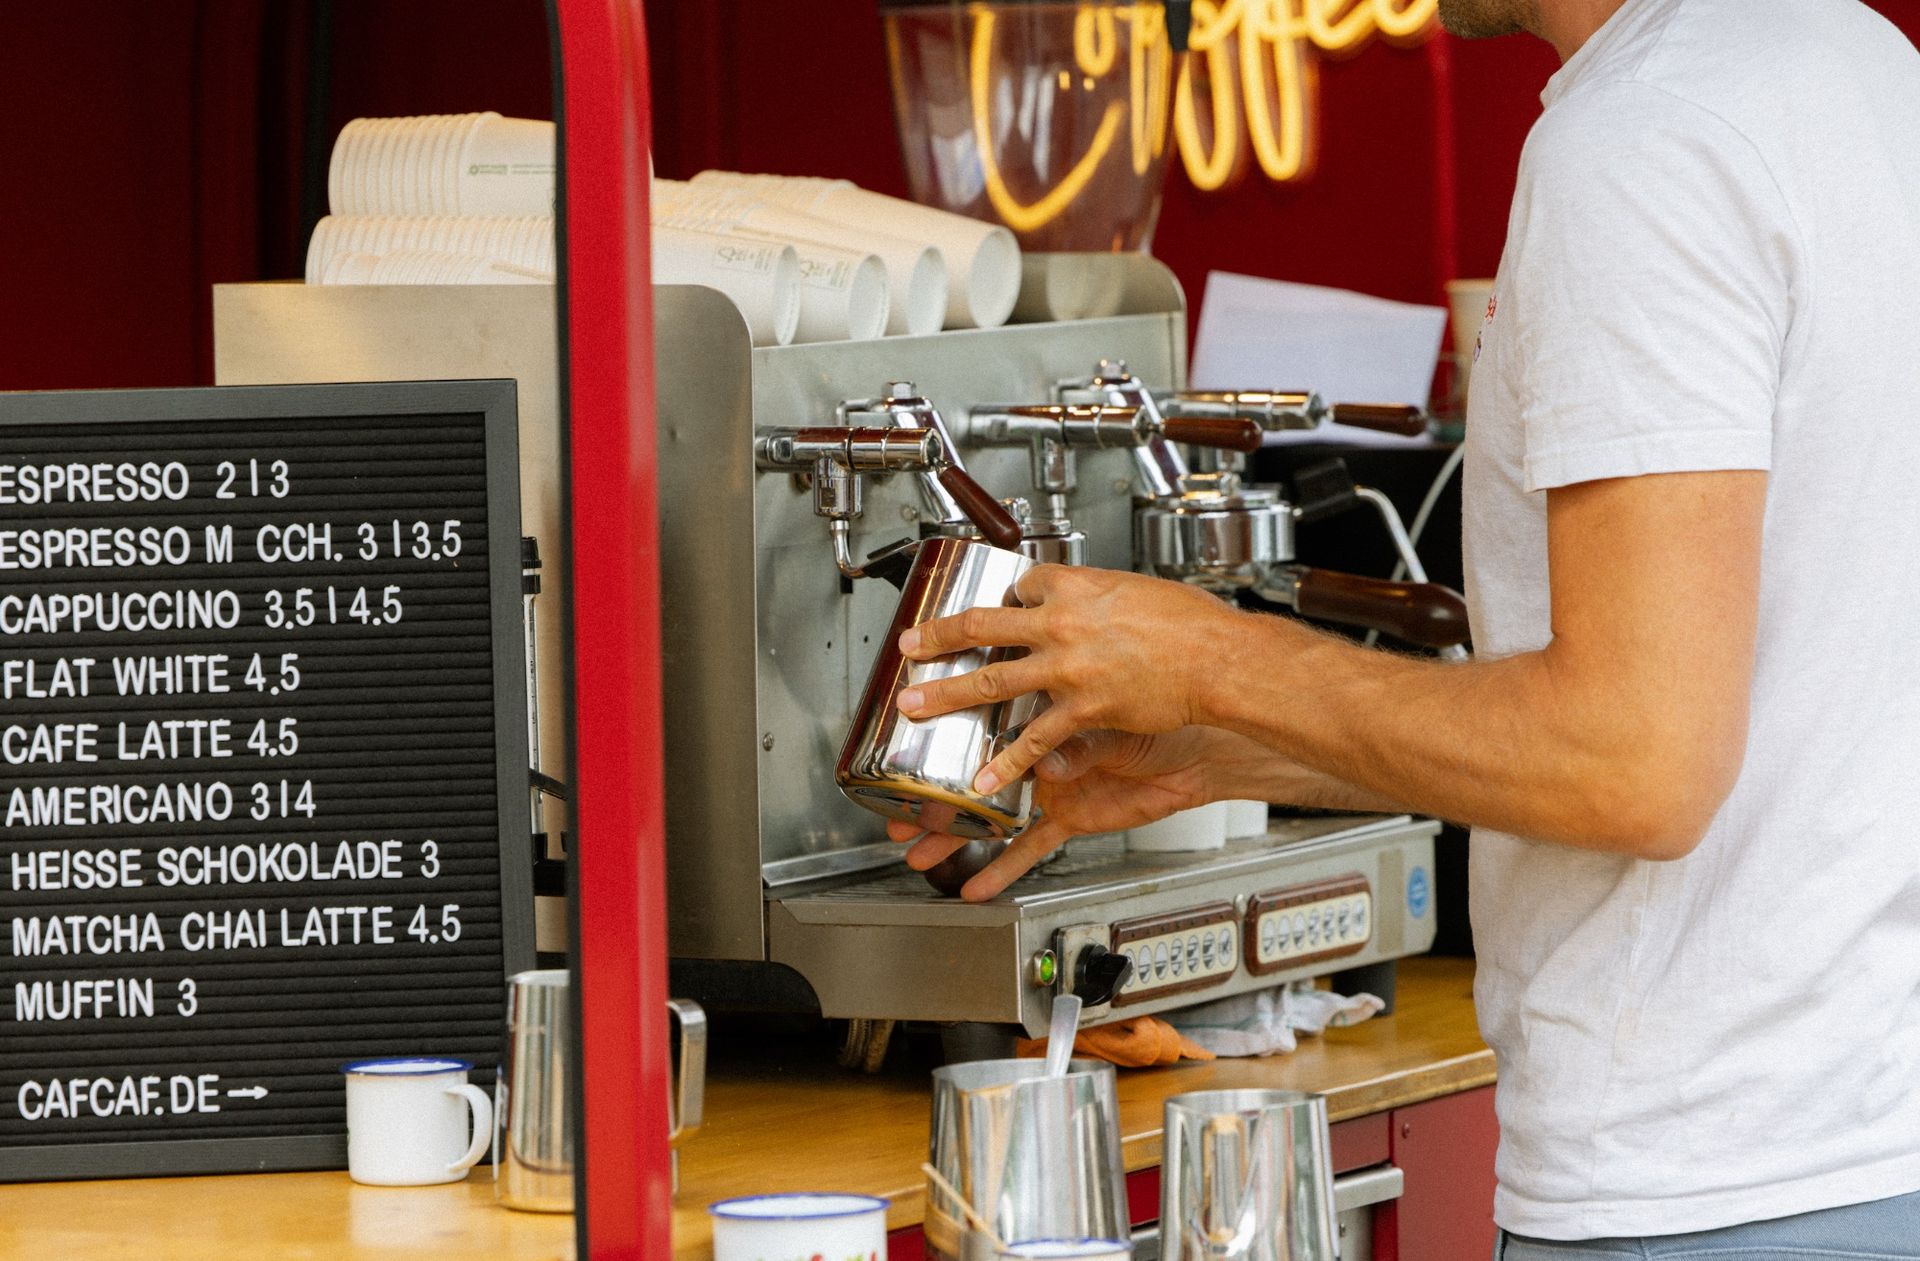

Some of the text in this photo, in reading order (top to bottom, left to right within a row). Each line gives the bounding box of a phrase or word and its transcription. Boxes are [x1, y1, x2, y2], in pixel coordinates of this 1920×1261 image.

[0, 461, 190, 505] ESPRESSO
[0, 525, 191, 569] ESPRESSO
[205, 524, 233, 564] M
[256, 522, 343, 563] CCH.
[0, 589, 241, 635] CAPPUCCINO
[3, 652, 301, 700] FLAT WHITE 4.5
[1, 717, 299, 765] CAFE LATTE 4.5
[5, 781, 233, 828] AMERICANO
[11, 839, 440, 891] HEISSE SCHOKOLADE 3
[12, 903, 462, 957] MATCHA CHAI LATTE 4.5
[15, 977, 198, 1022] MUFFIN 3
[17, 1073, 221, 1121] CAFCAF.DE
